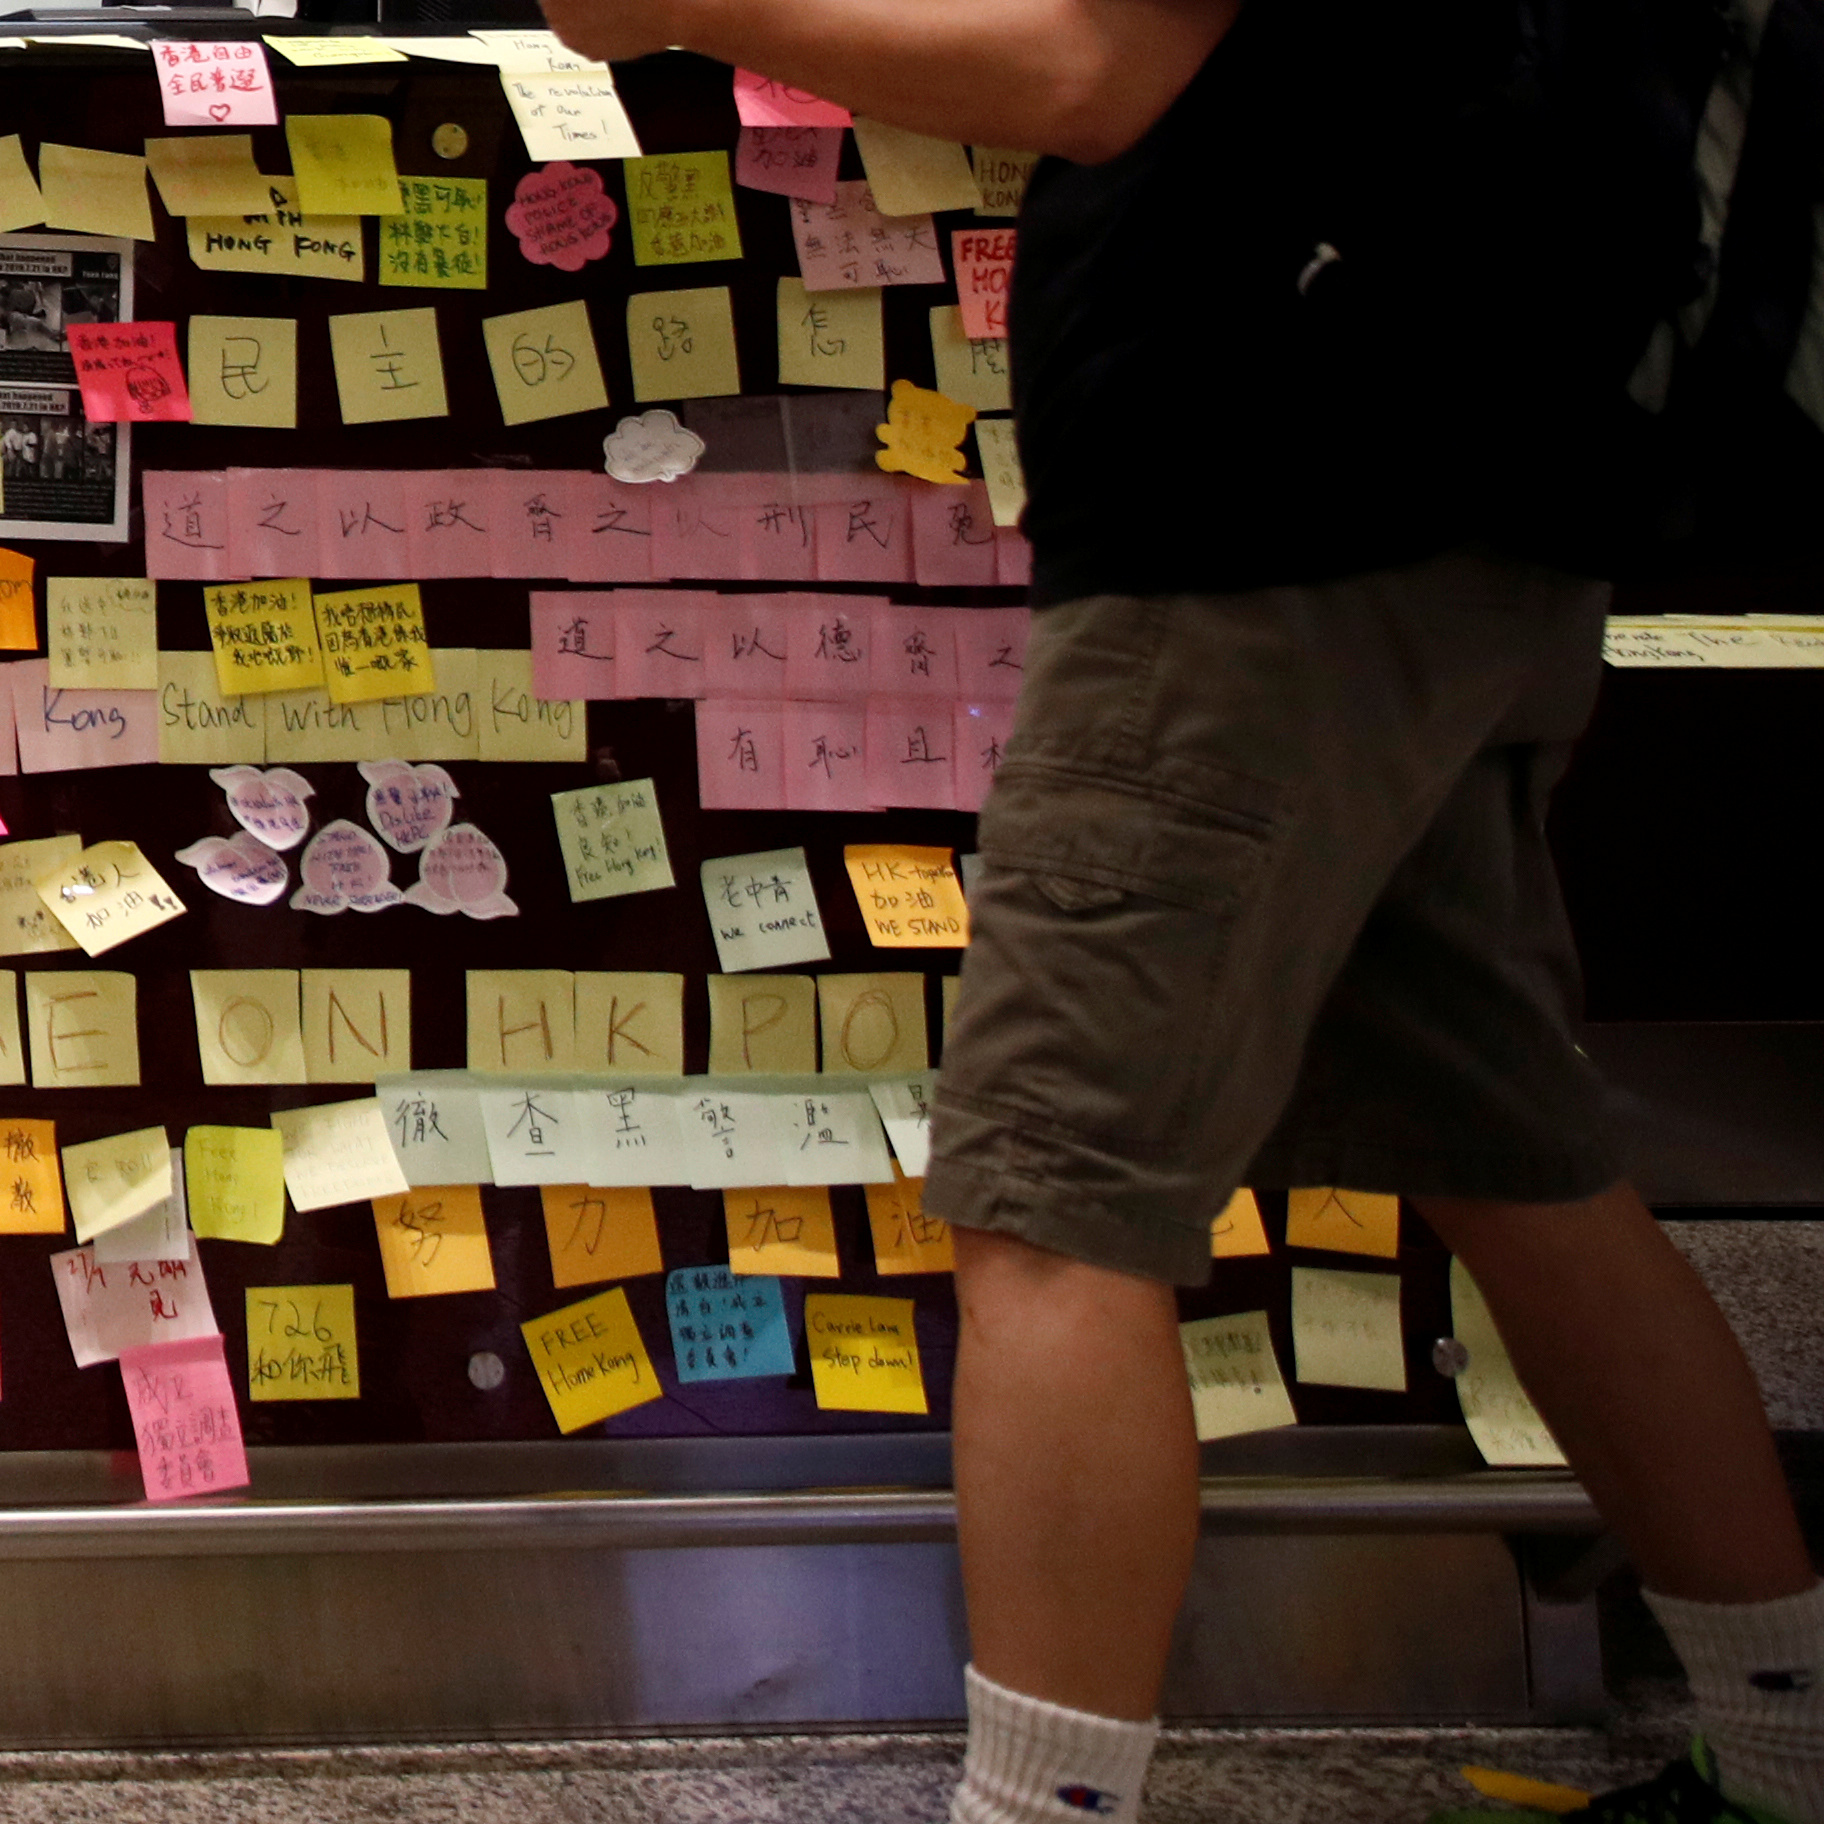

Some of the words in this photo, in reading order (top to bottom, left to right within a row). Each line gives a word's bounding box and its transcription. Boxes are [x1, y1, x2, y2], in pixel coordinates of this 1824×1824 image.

[159, 44, 254, 64] 香港自由
[205, 230, 272, 254] HONG
[43, 687, 127, 739] Kong
[162, 684, 253, 731] Stand
[490, 679, 574, 741] Kong
[908, 917, 961, 935] STAND
[540, 1313, 609, 1352] FREE
